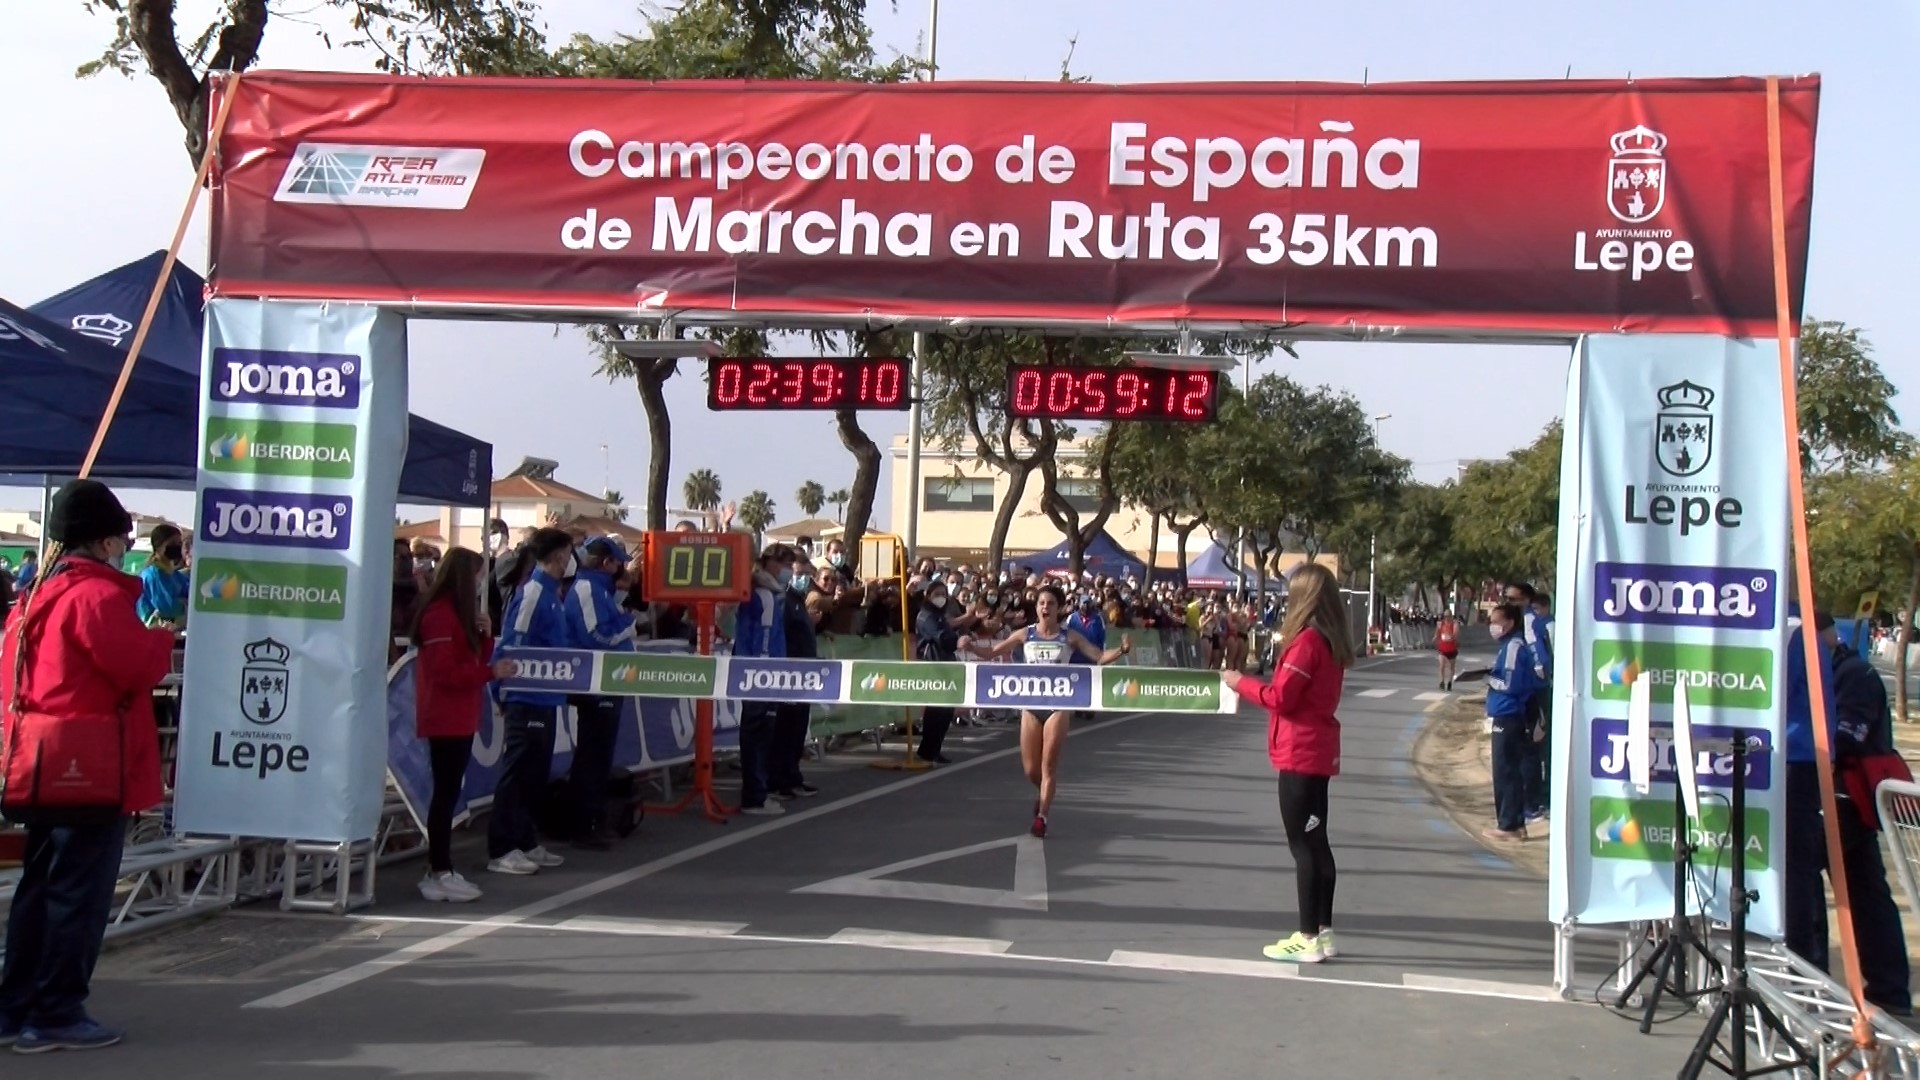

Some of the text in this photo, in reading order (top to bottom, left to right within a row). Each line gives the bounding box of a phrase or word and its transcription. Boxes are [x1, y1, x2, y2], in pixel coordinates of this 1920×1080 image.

[371, 156, 438, 172] RFEA
[568, 120, 1420, 201] Campeonato de España
[364, 172, 467, 186] ATLETISMO
[560, 197, 1437, 266] de Marcha en Ruta 35km
[1596, 229, 1672, 238] AYUNTAMIENTO
[1575, 231, 1694, 281] Lepe
[717, 362, 900, 404] 02:39:10
[1016, 370, 1210, 414] 00:59:12
[250, 442, 351, 463] IBERDROLA
[1645, 483, 1721, 494] AYUNTAMIENTO
[1625, 485, 1743, 536] Lepe
[668, 546, 727, 586] 00
[240, 582, 341, 604] IBERDROLA
[1039, 650, 1050, 659] 41
[639, 670, 707, 684] IBERDROLA
[888, 678, 957, 692] IBERDROLA
[1140, 684, 1212, 697] IBERDROLA
[230, 730, 292, 741] AYUNTAMIENTO
[211, 731, 310, 779] Lepe
